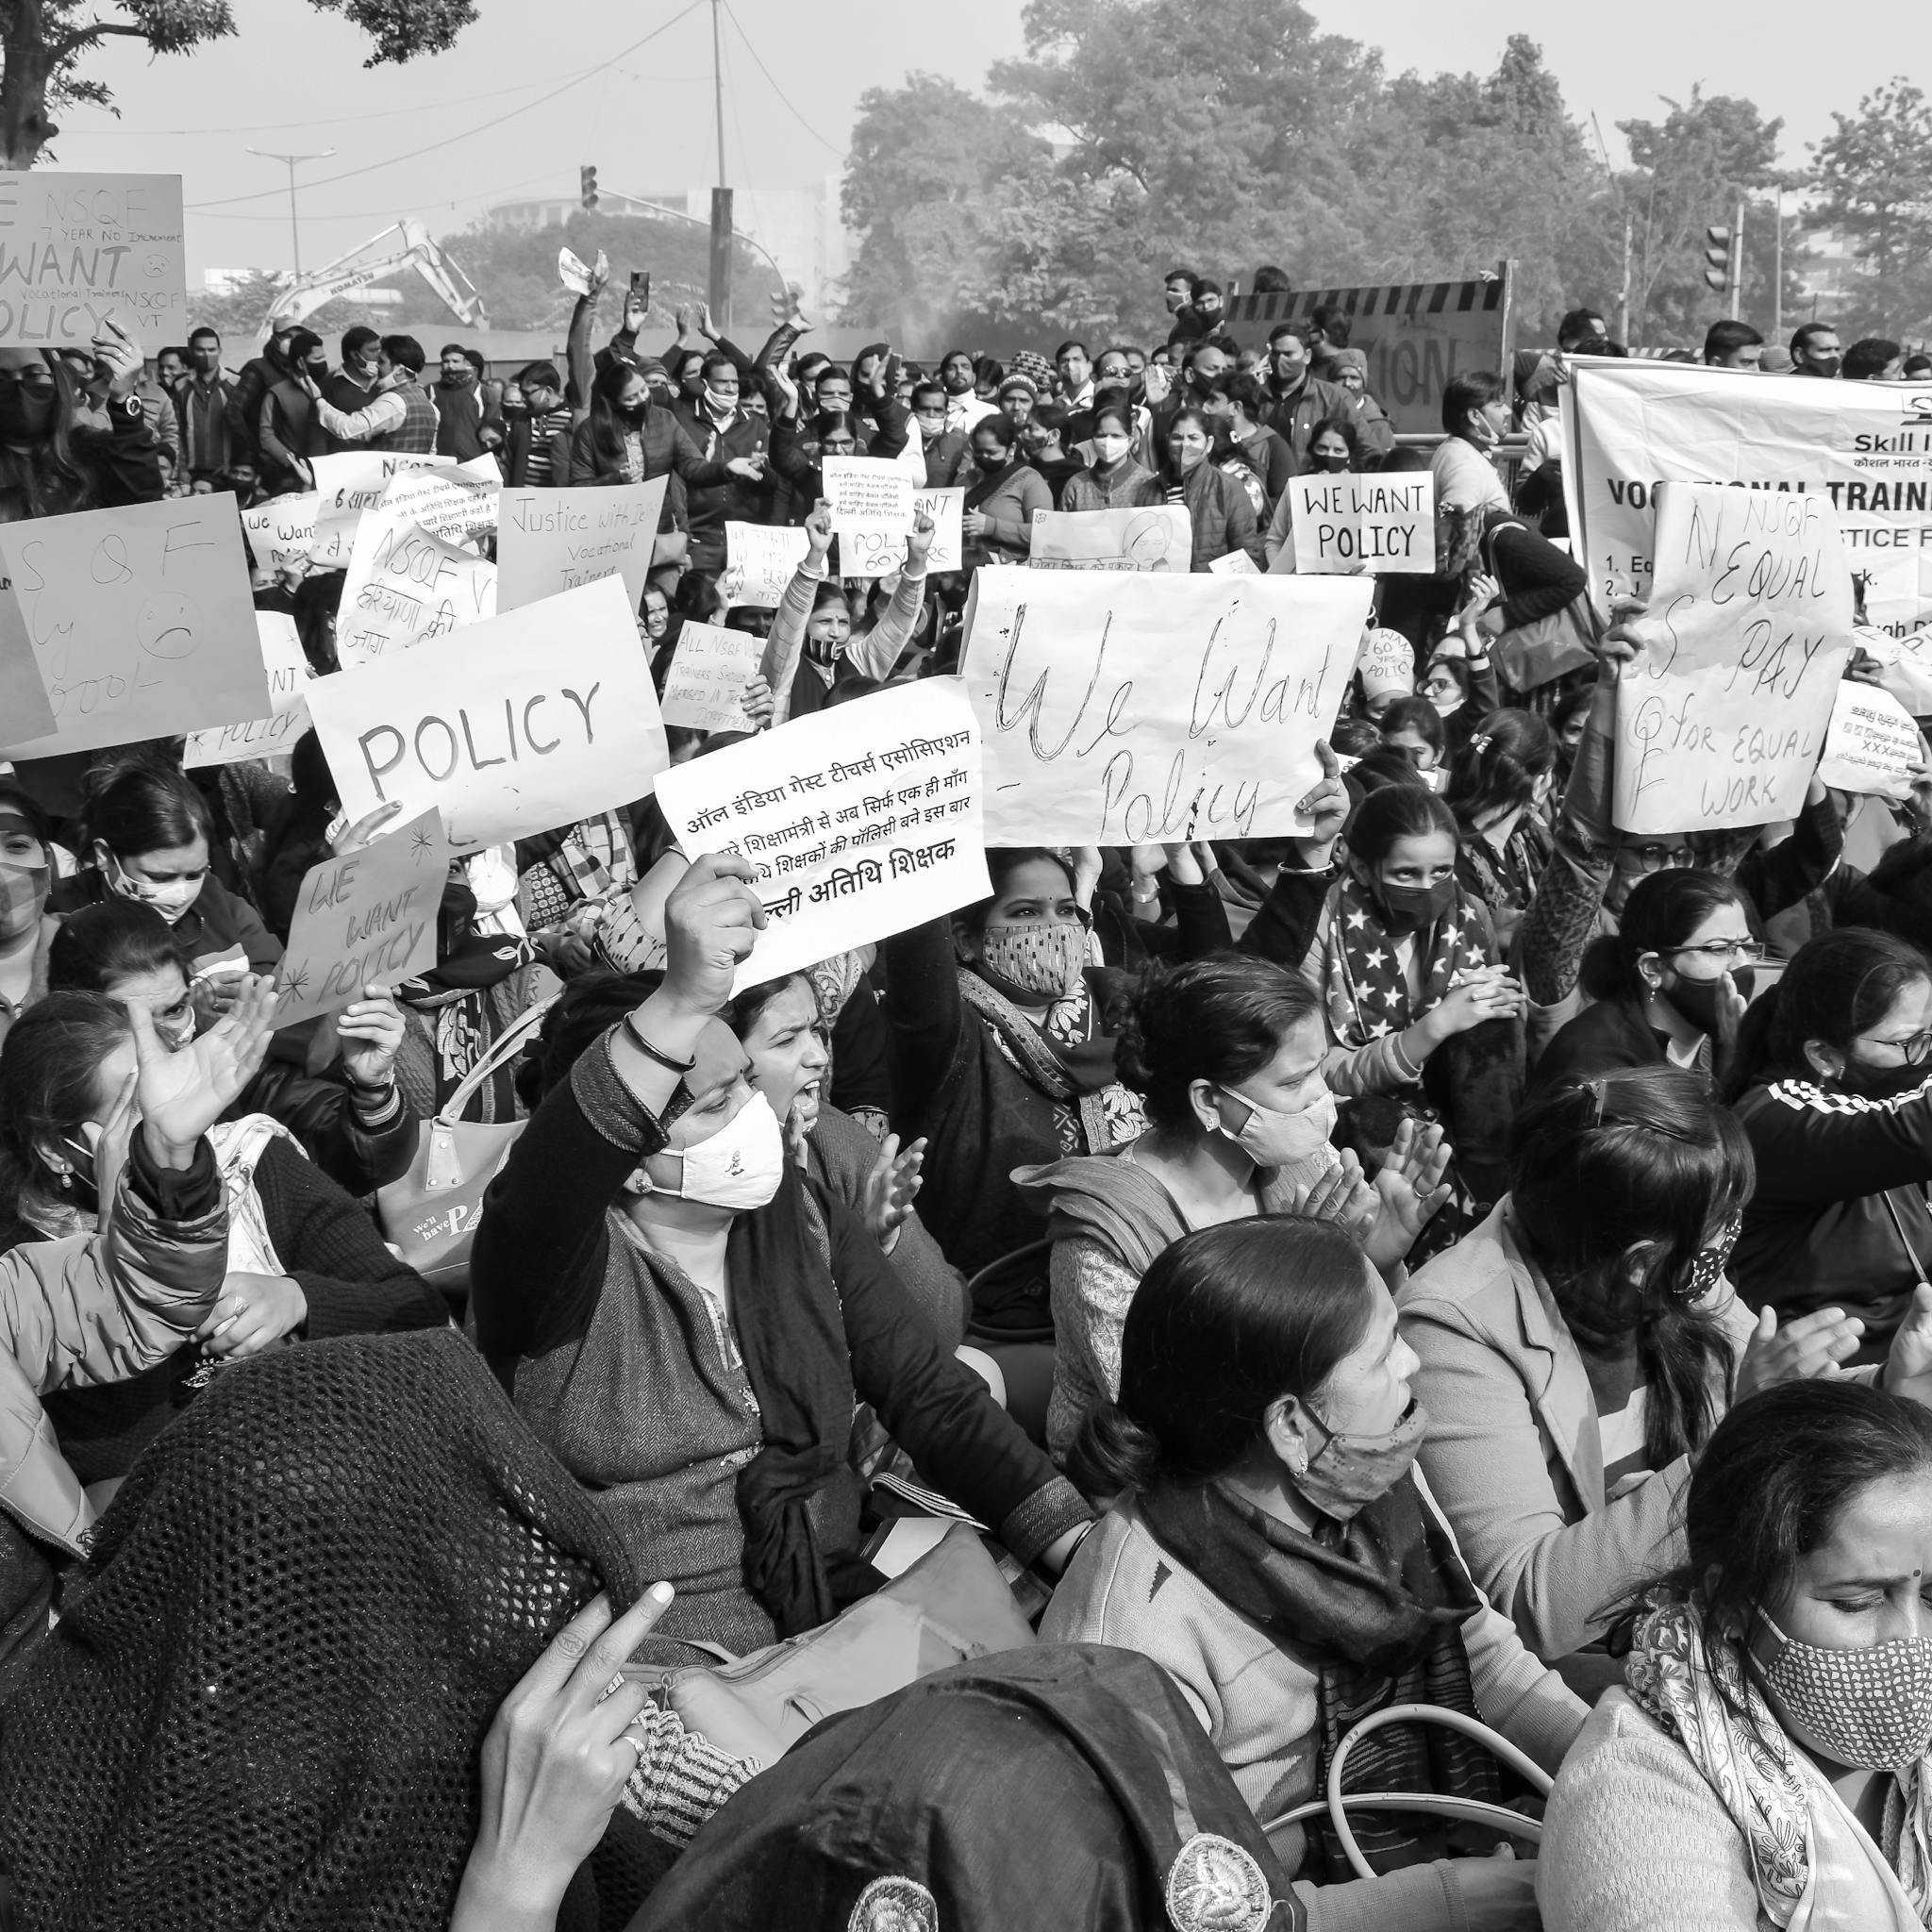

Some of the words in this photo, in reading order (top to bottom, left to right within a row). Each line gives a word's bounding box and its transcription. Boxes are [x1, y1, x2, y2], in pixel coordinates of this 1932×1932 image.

[61, 227, 94, 242] YEAR
[102, 230, 122, 242] NO
[0, 242, 132, 288] WANT
[330, 272, 375, 295] KOMATSU
[1855, 432, 1913, 452] Skill
[1893, 458, 1920, 468] भारत
[513, 498, 589, 532] Justice
[1305, 486, 1341, 515] WE
[1352, 485, 1424, 514] WANT
[276, 525, 315, 541] Wan
[568, 532, 635, 560] Vocational
[1320, 524, 1416, 558] POLICY
[1711, 541, 1826, 605] EQUAL
[677, 627, 705, 653] ALL
[1374, 641, 1392, 655] 60
[1724, 619, 1826, 699] PAY
[996, 603, 1138, 761] We
[1189, 617, 1331, 740] Want
[358, 682, 601, 802] POLICY
[1732, 724, 1813, 764] EQUAL
[687, 806, 730, 834] ऑल
[733, 785, 787, 817] इंडिया
[790, 773, 826, 796] गेस्ट
[828, 751, 876, 784] टीचर्स
[879, 730, 971, 771] एसोसिएशन
[1099, 749, 1260, 844] Policy
[1701, 774, 1777, 818] WORK
[744, 817, 816, 857] शिक्षामंत्री
[817, 810, 833, 830] से
[835, 805, 859, 824] अब
[863, 790, 894, 816] सिर्फ
[898, 788, 922, 806] एक
[925, 777, 940, 797] ही
[943, 768, 968, 790] माँग
[775, 841, 826, 875] शिक्षकों
[829, 836, 849, 858] की
[851, 815, 896, 847] पॉलिसी
[900, 808, 921, 828] बने
[924, 804, 945, 823] इस
[949, 796, 971, 815] बार
[308, 859, 359, 915] WE
[808, 858, 884, 903] अतिथि
[889, 838, 957, 879] शिक्षक
[346, 883, 422, 949] WANT
[317, 921, 425, 1004] POLICY
